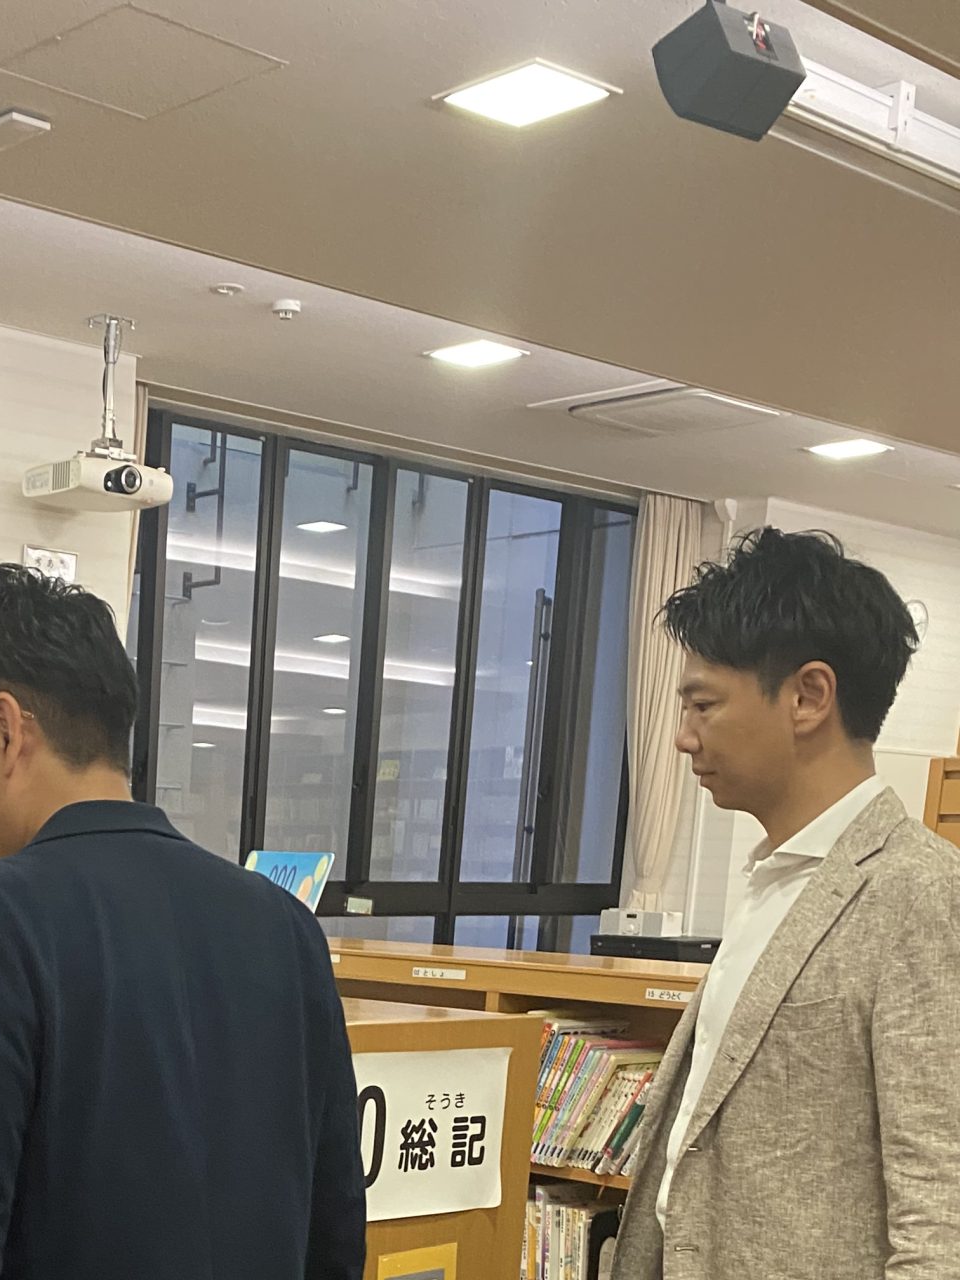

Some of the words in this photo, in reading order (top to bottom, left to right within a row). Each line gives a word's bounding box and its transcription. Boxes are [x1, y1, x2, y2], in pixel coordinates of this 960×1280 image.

[425, 1092, 466, 1111] そうき
[398, 1115, 486, 1172] 総記
